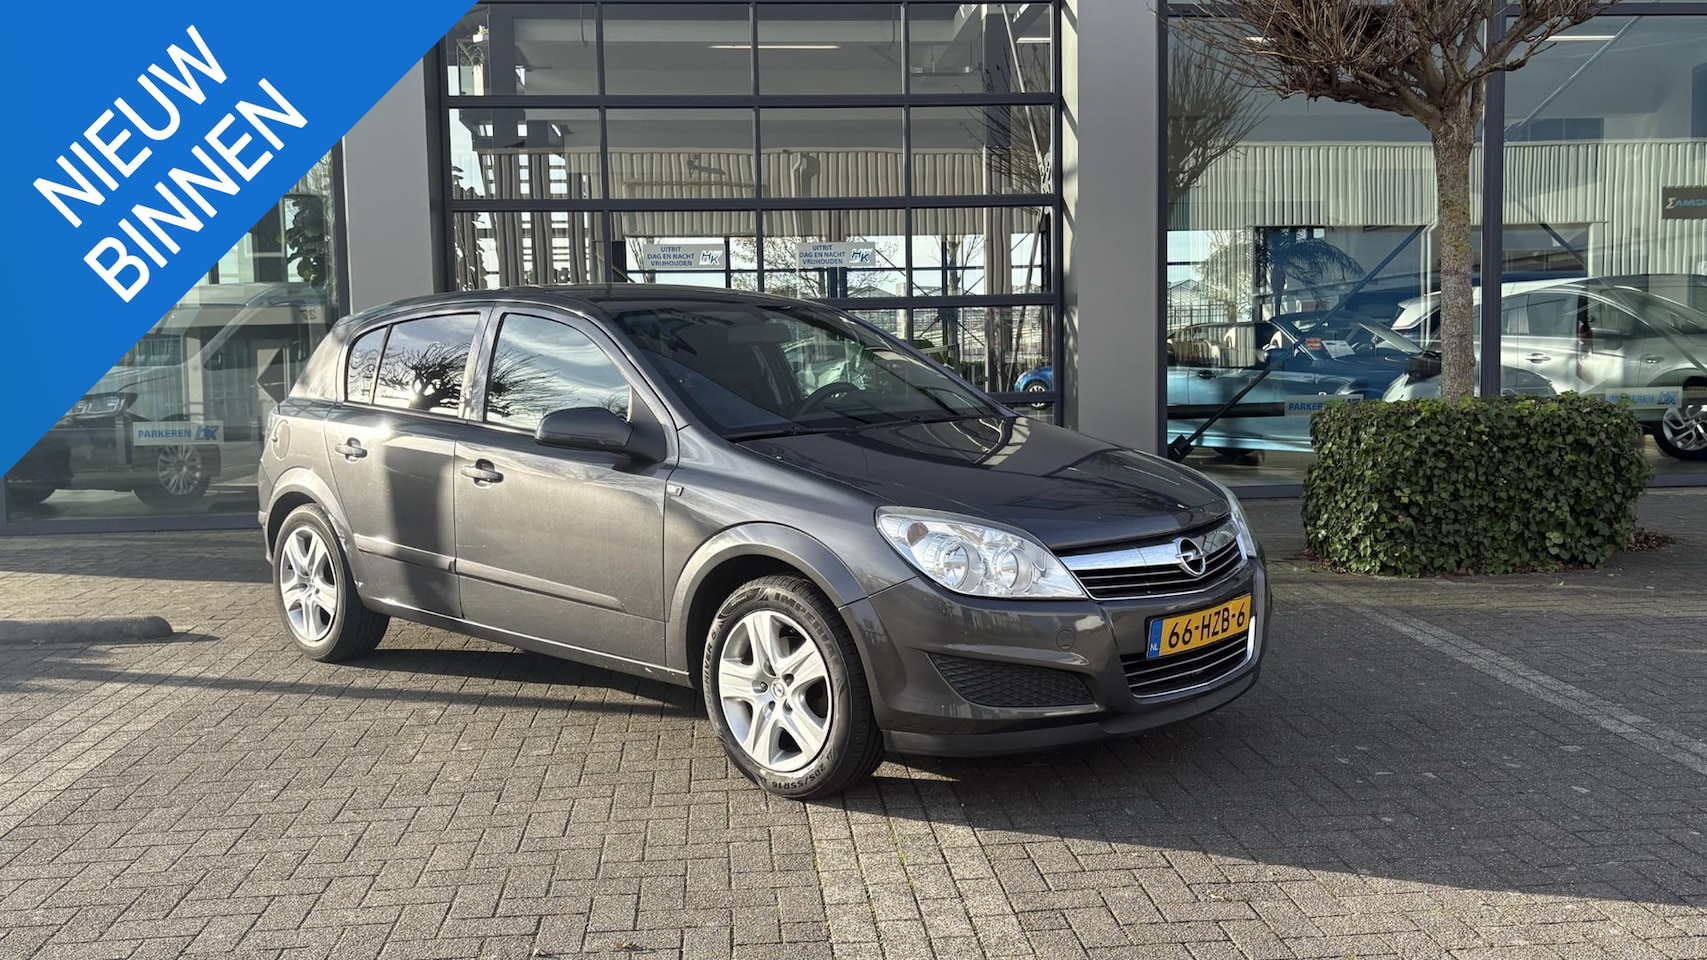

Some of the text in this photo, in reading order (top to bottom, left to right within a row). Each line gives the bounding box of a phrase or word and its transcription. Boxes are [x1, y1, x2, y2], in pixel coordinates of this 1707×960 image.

[1288, 401, 1324, 411] PARKER
[137, 428, 192, 439] PARKEREN
[1168, 602, 1246, 649] 66-HZB-6
[1149, 643, 1160, 652] NL
[771, 763, 826, 790] 205/55R16
